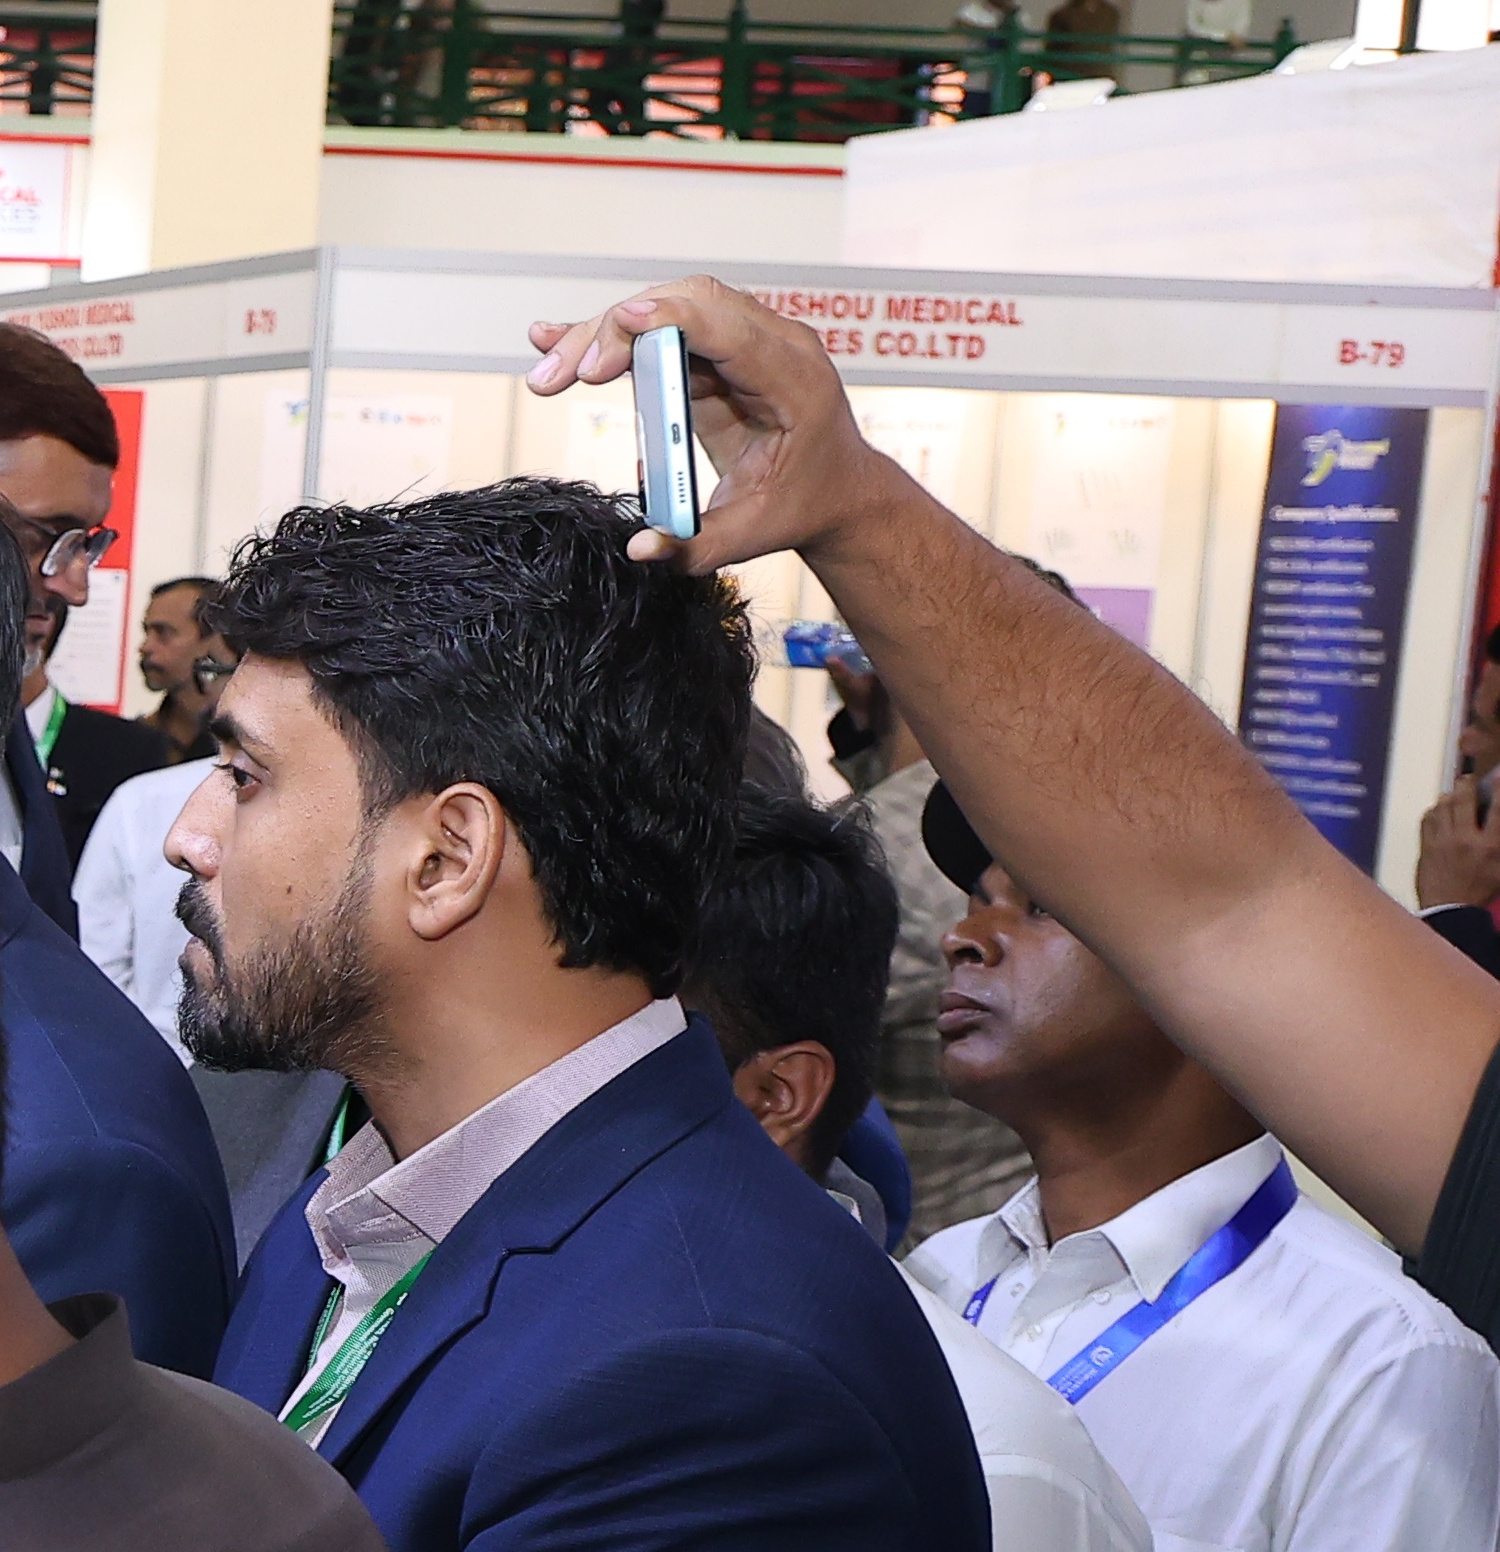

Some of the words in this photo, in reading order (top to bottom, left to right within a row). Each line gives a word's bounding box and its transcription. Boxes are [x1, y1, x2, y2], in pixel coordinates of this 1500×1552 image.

[753, 291, 875, 320] USHOU
[887, 294, 1024, 326] MEDICAL
[1339, 338, 1406, 368] B-79
